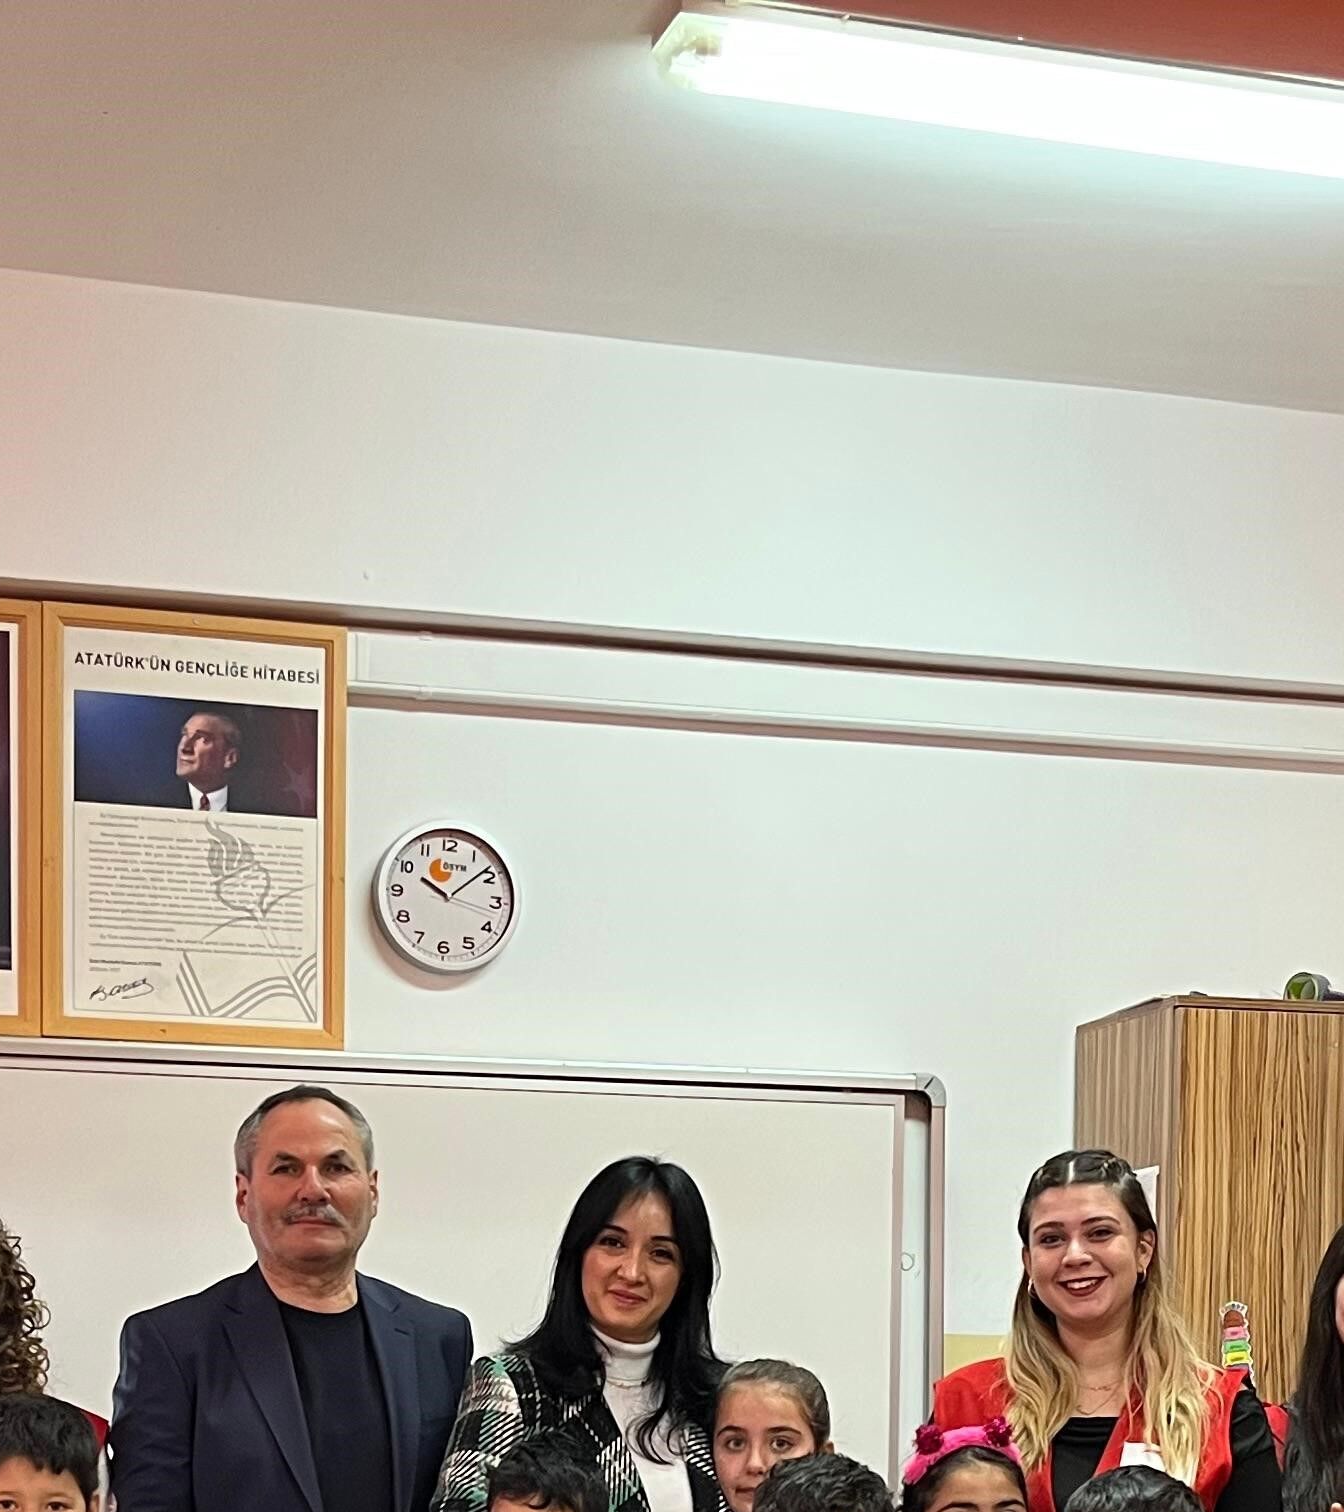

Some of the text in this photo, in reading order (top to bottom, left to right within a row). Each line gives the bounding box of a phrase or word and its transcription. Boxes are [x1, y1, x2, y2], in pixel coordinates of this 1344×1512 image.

[74, 650, 320, 685] ATATÜRK'ÜN GENÇLİĞE HİTABESİ
[420, 843, 430, 857] 11
[442, 839, 458, 852] 12
[400, 860, 414, 873] 10
[483, 870, 496, 884] 2
[391, 884, 403, 897] 9
[489, 896, 502, 909] 3
[396, 910, 410, 923] 8
[481, 921, 493, 933] 4
[414, 931, 425, 944] 7
[462, 937, 475, 949] 5
[437, 941, 450, 954] 6
